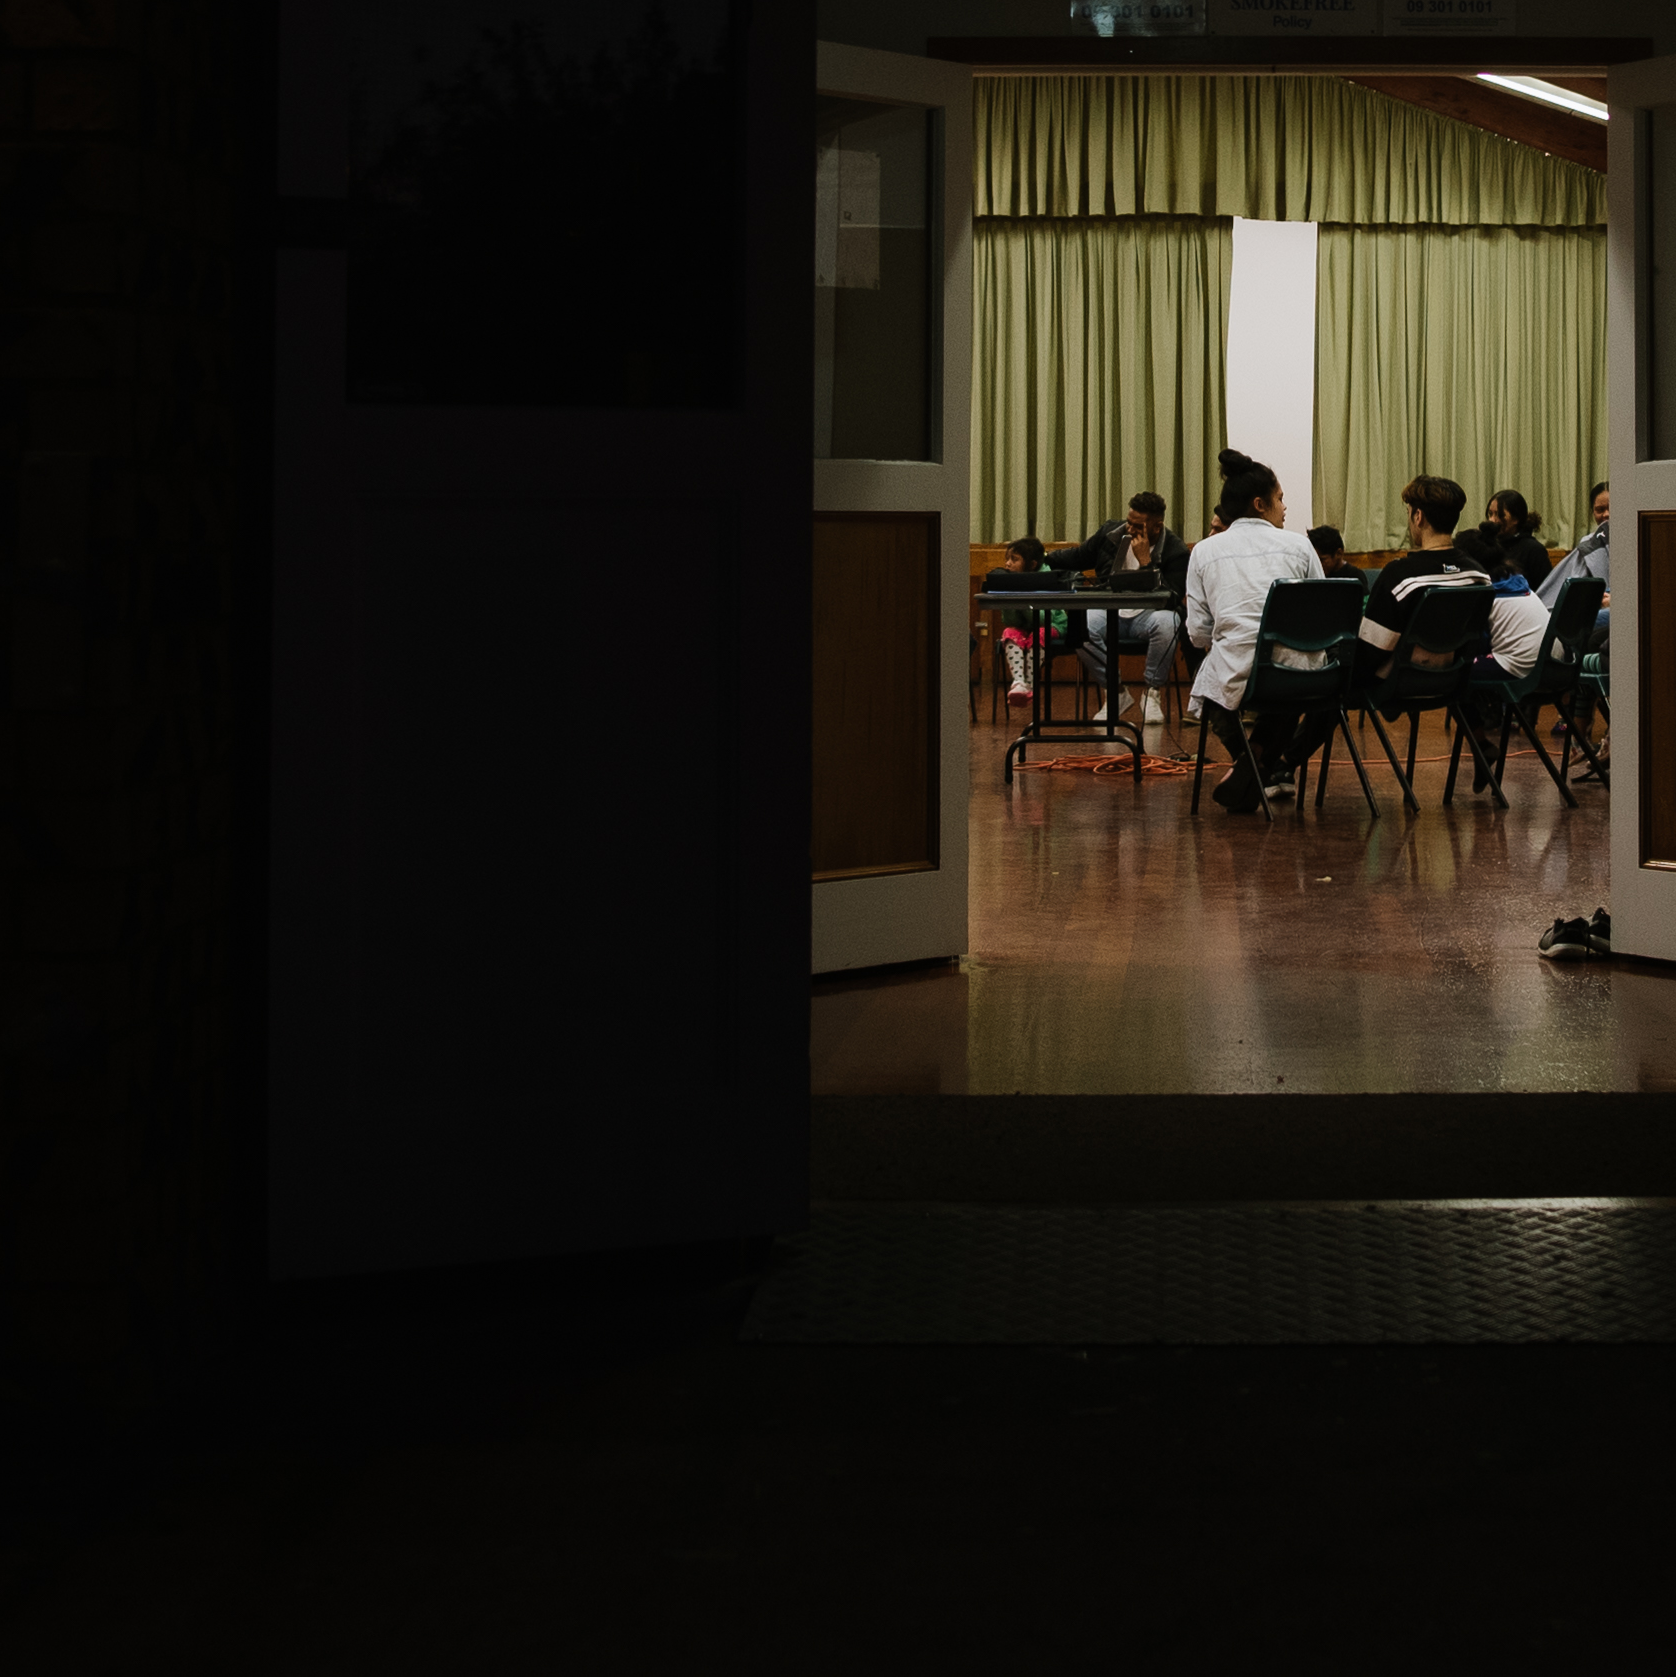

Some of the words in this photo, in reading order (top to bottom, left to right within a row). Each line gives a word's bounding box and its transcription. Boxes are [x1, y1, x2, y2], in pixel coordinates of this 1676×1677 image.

[1150, 4, 1194, 18] 0101
[1406, 0, 1424, 13] 09
[1428, 0, 1453, 13] 301
[1458, 0, 1493, 13] 0101
[1273, 15, 1313, 30] Policy
